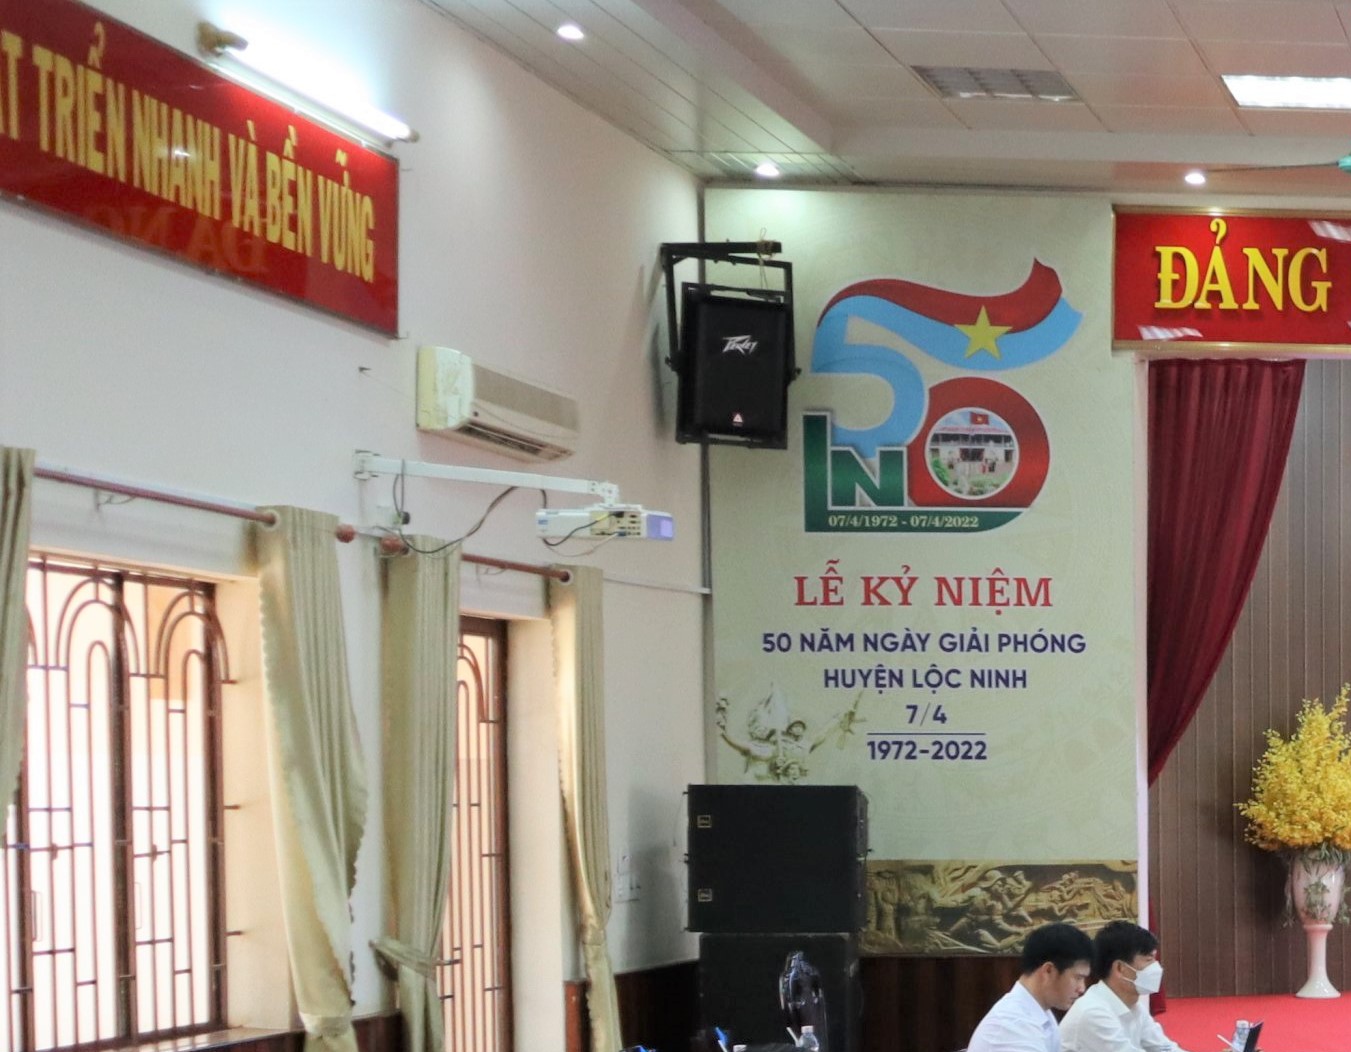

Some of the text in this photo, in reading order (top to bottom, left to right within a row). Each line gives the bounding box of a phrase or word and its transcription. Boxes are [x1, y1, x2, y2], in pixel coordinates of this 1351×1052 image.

[0, 29, 22, 139] T
[33, 22, 127, 183] TRIỂN
[132, 89, 221, 221] NHANH
[228, 120, 260, 237] VÀ
[266, 125, 312, 257] BỀN
[318, 149, 374, 283] VỮNG
[1154, 217, 1332, 312] ĐẢNG
[828, 515, 898, 528] 07/4/1972
[909, 515, 979, 528] 07/4/2022
[794, 558, 1053, 616] LỄ KỶ NIỆM
[762, 627, 1086, 654] 50 NĂM NGÀY GIẢI PHÓNG
[824, 663, 1027, 693] HUYỆN LỘC NINH
[867, 740, 987, 761] 1972-2022
